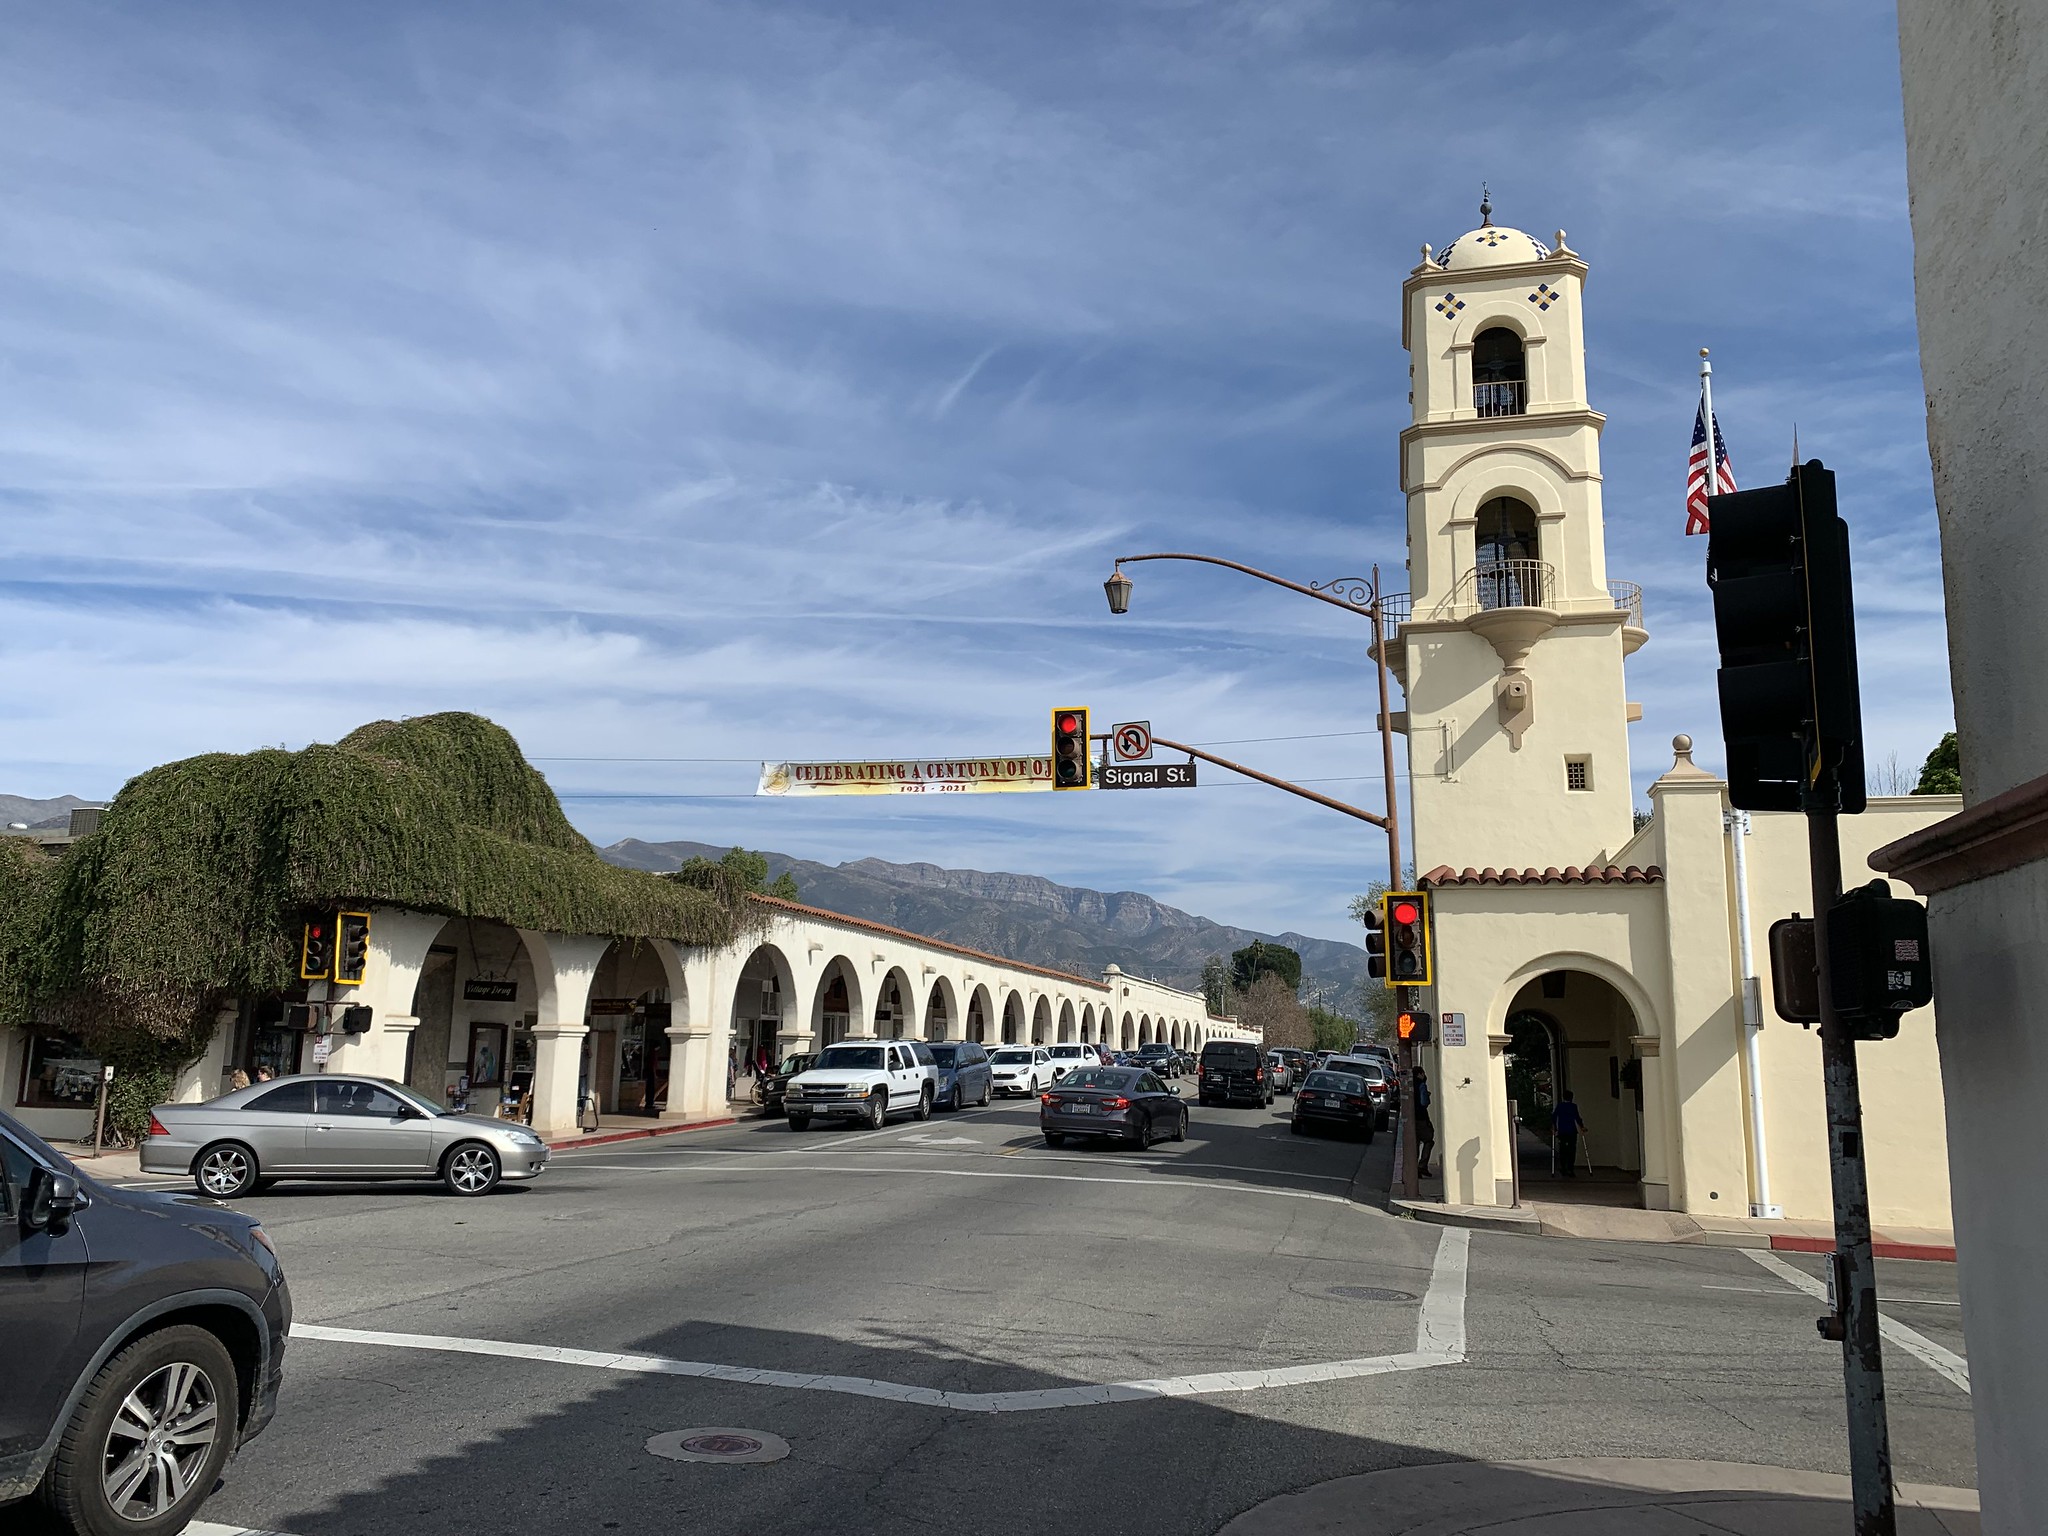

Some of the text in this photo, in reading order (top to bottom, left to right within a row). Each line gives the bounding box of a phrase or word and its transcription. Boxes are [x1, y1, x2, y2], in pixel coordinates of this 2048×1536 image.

[795, 759, 1053, 780] CELEBRATING A CENTURY OF OJ
[1105, 767, 1190, 786] Signal St.
[900, 785, 925, 793] 1921
[939, 784, 967, 792] 2021
[490, 984, 512, 996] Drug
[1443, 1015, 1452, 1023] NO
